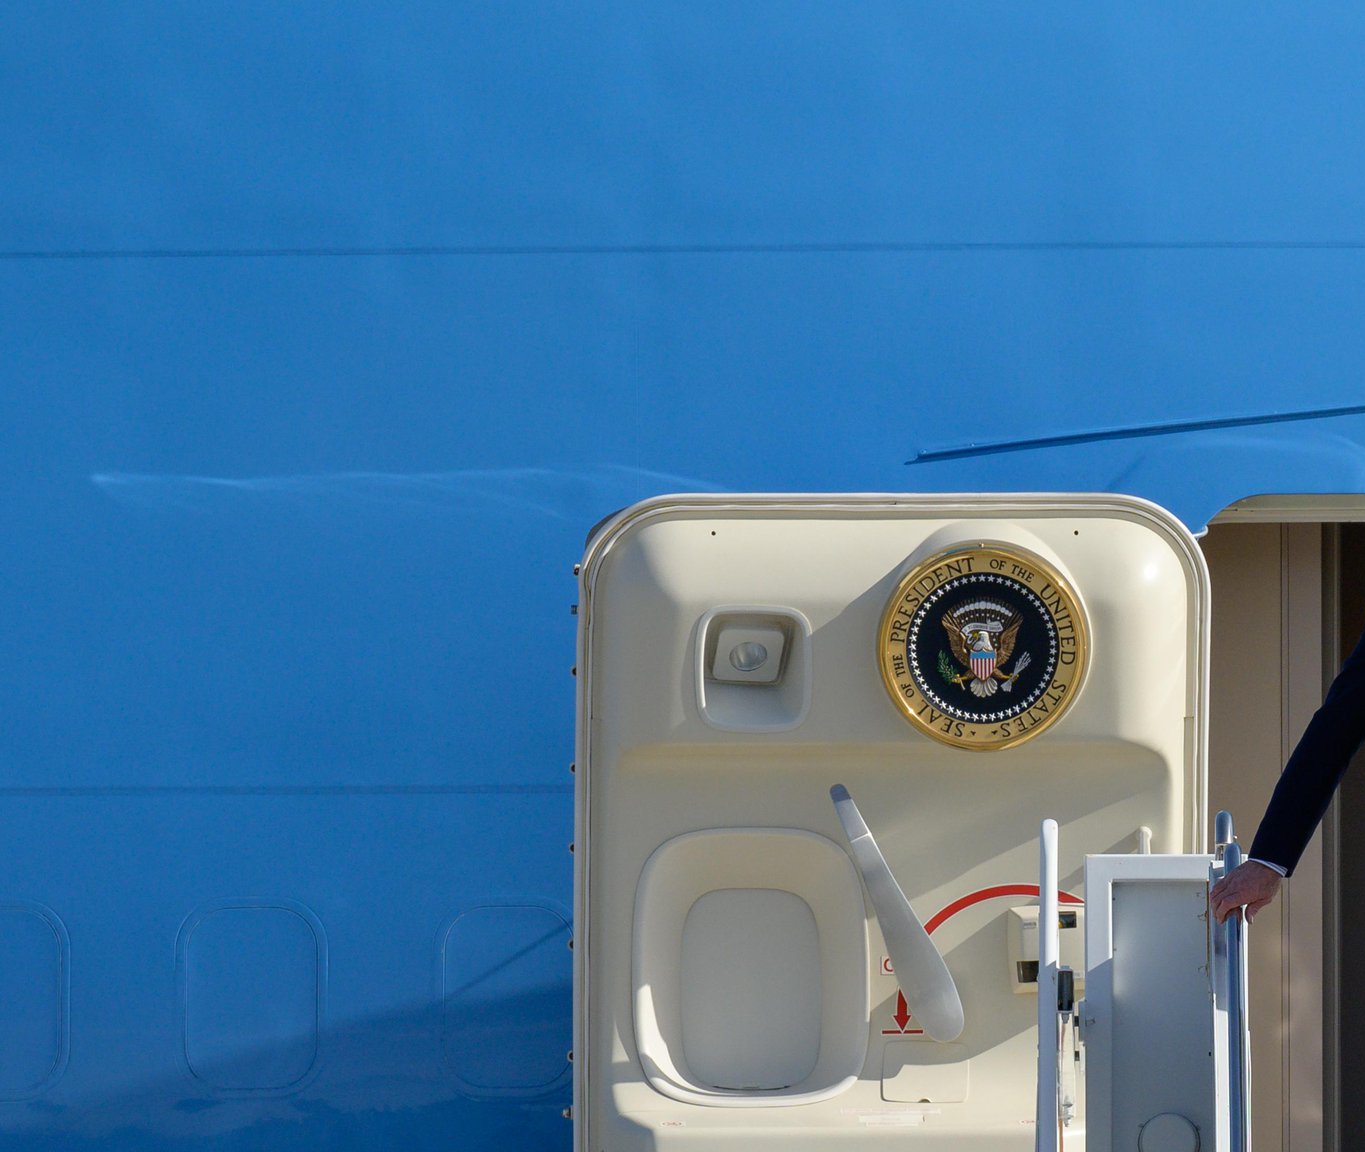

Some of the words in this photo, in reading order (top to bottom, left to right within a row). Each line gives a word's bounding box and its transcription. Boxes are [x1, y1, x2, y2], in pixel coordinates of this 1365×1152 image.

[989, 558, 1007, 571] OF
[1011, 563, 1035, 583] THE
[890, 557, 975, 643] PRESIDENT
[1040, 582, 1076, 665] UNITED
[893, 654, 906, 677] THE
[901, 683, 915, 698] OF
[917, 700, 966, 737] SEAL
[1000, 679, 1067, 737] STATES
